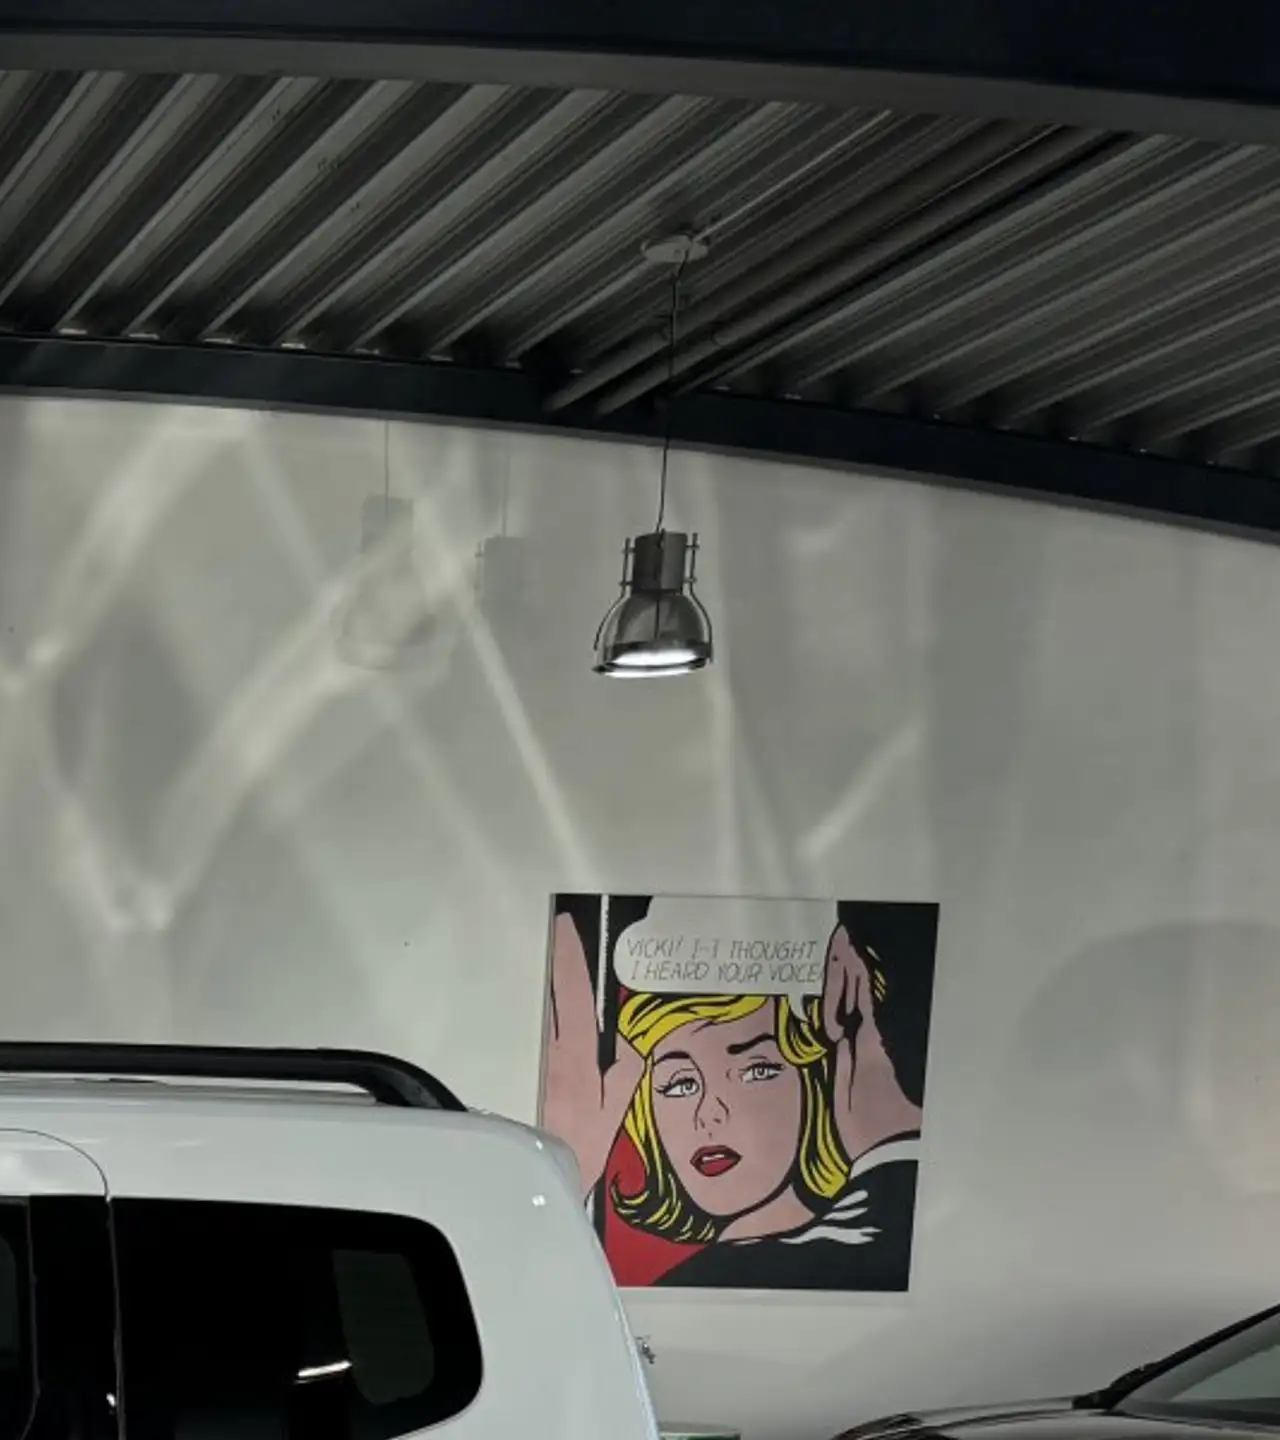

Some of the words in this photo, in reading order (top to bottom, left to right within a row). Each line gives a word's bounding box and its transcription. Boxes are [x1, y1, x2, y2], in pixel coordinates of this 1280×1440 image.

[729, 940, 818, 961] THOUGHT
[631, 960, 640, 980] I
[644, 960, 710, 981] HEARD
[718, 962, 763, 983] YOUR
